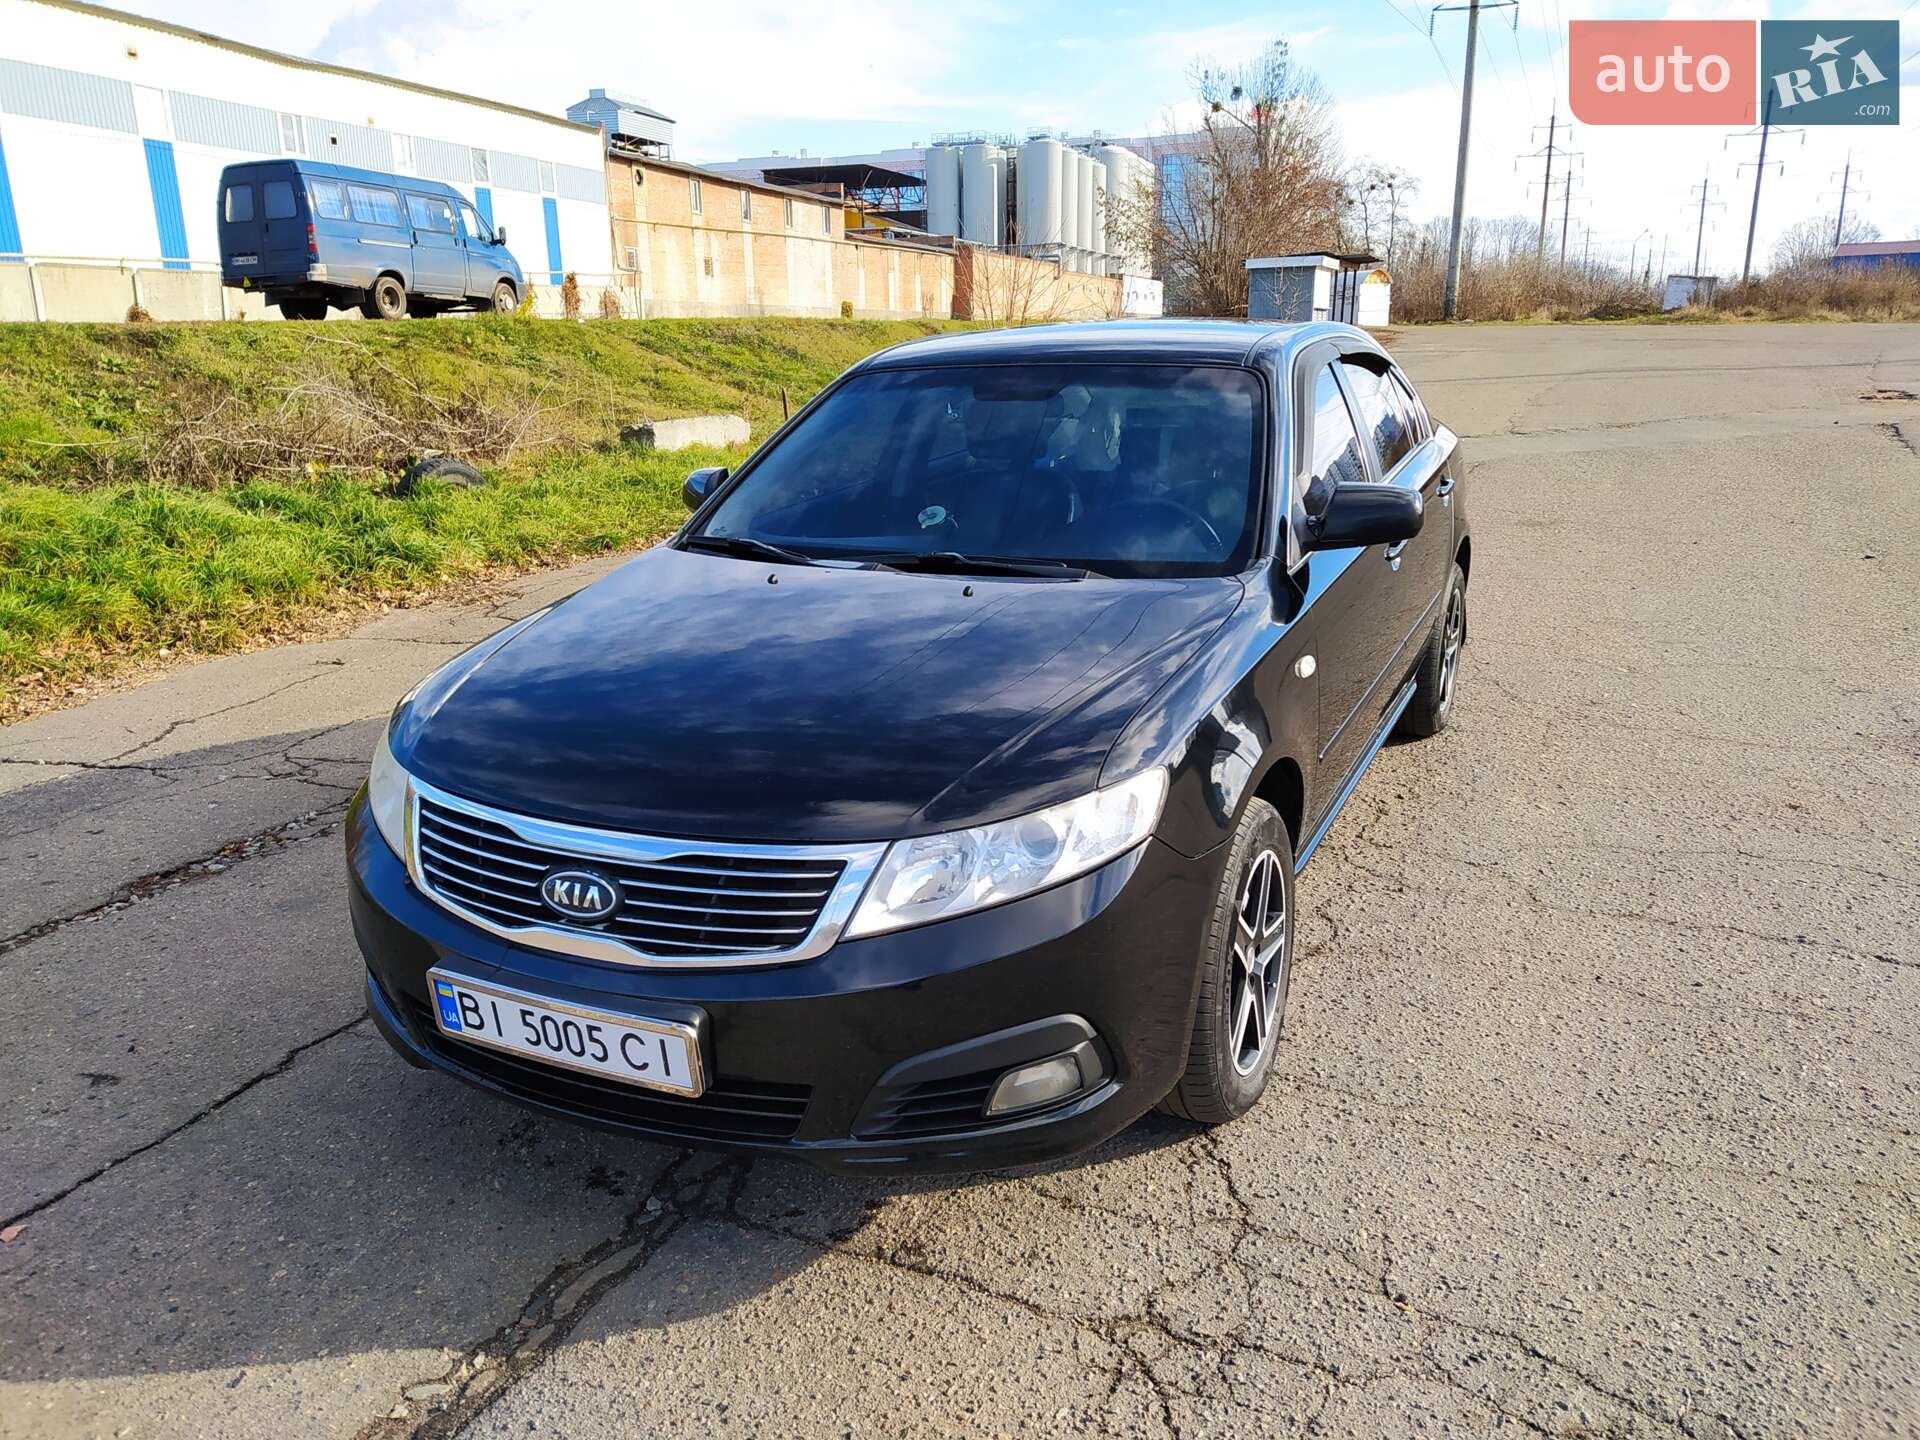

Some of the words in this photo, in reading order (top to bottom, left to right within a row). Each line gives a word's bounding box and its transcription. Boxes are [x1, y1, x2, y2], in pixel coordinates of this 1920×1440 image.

[553, 879, 602, 910] KIA
[443, 1009, 460, 1025] UA
[457, 991, 503, 1038] BI
[520, 1008, 609, 1063] 5005
[620, 1032, 671, 1077] CI
